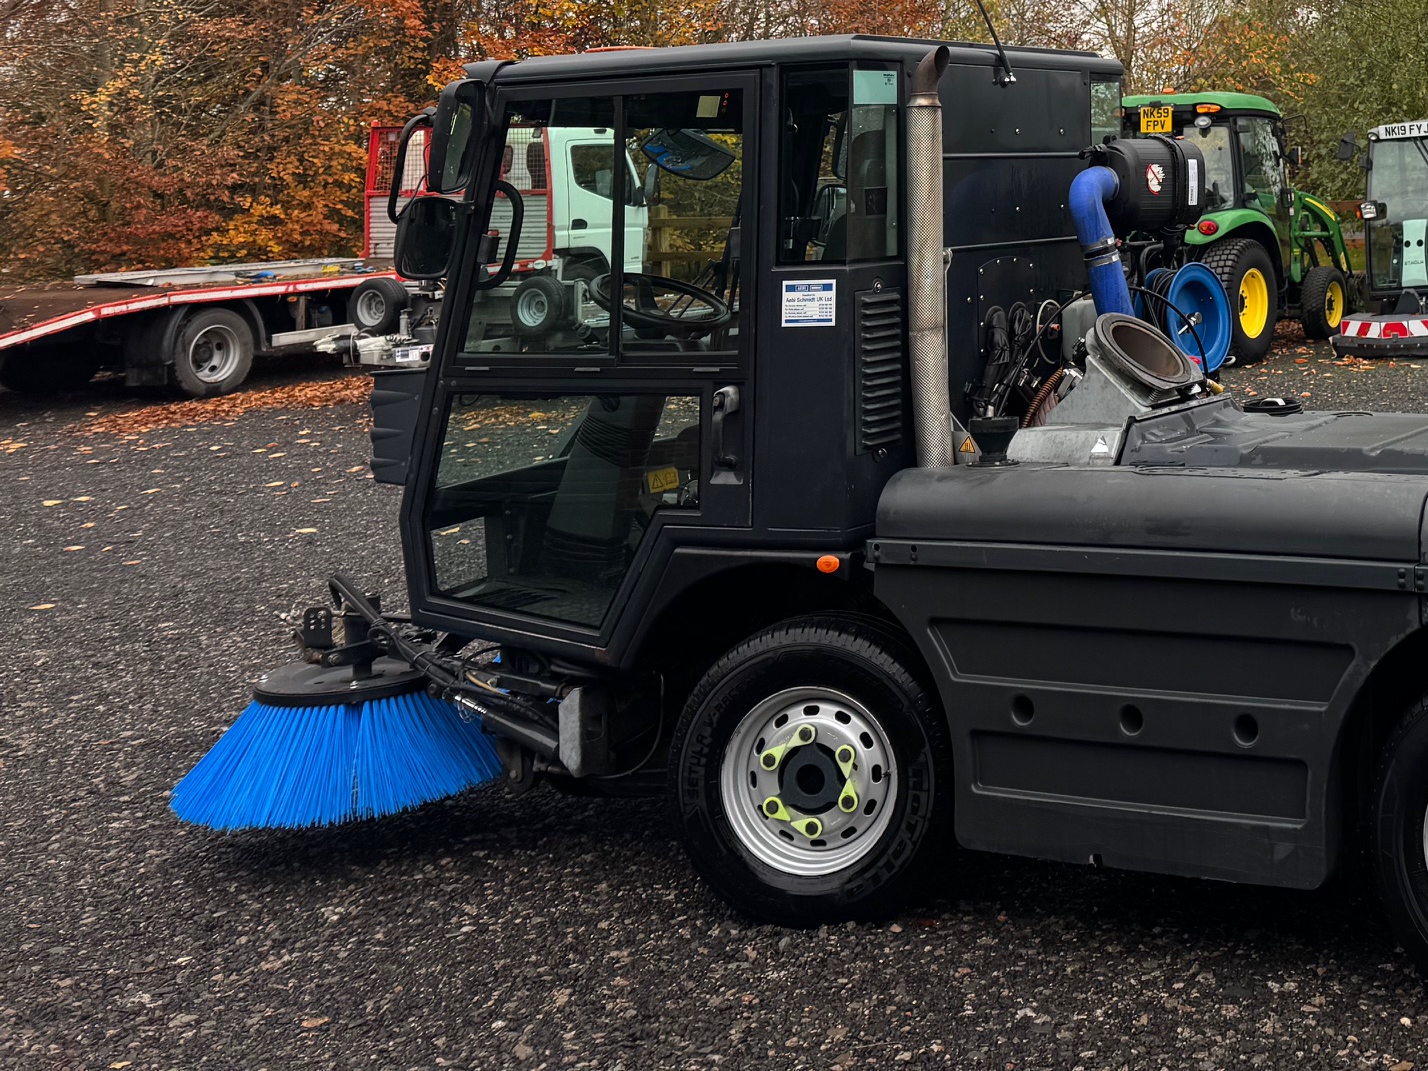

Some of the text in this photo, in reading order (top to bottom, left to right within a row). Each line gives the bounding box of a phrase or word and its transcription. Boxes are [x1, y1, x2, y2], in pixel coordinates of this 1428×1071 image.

[1143, 107, 1169, 119] NK59
[1146, 120, 1166, 131] FPV
[1384, 125, 1407, 137] NK19
